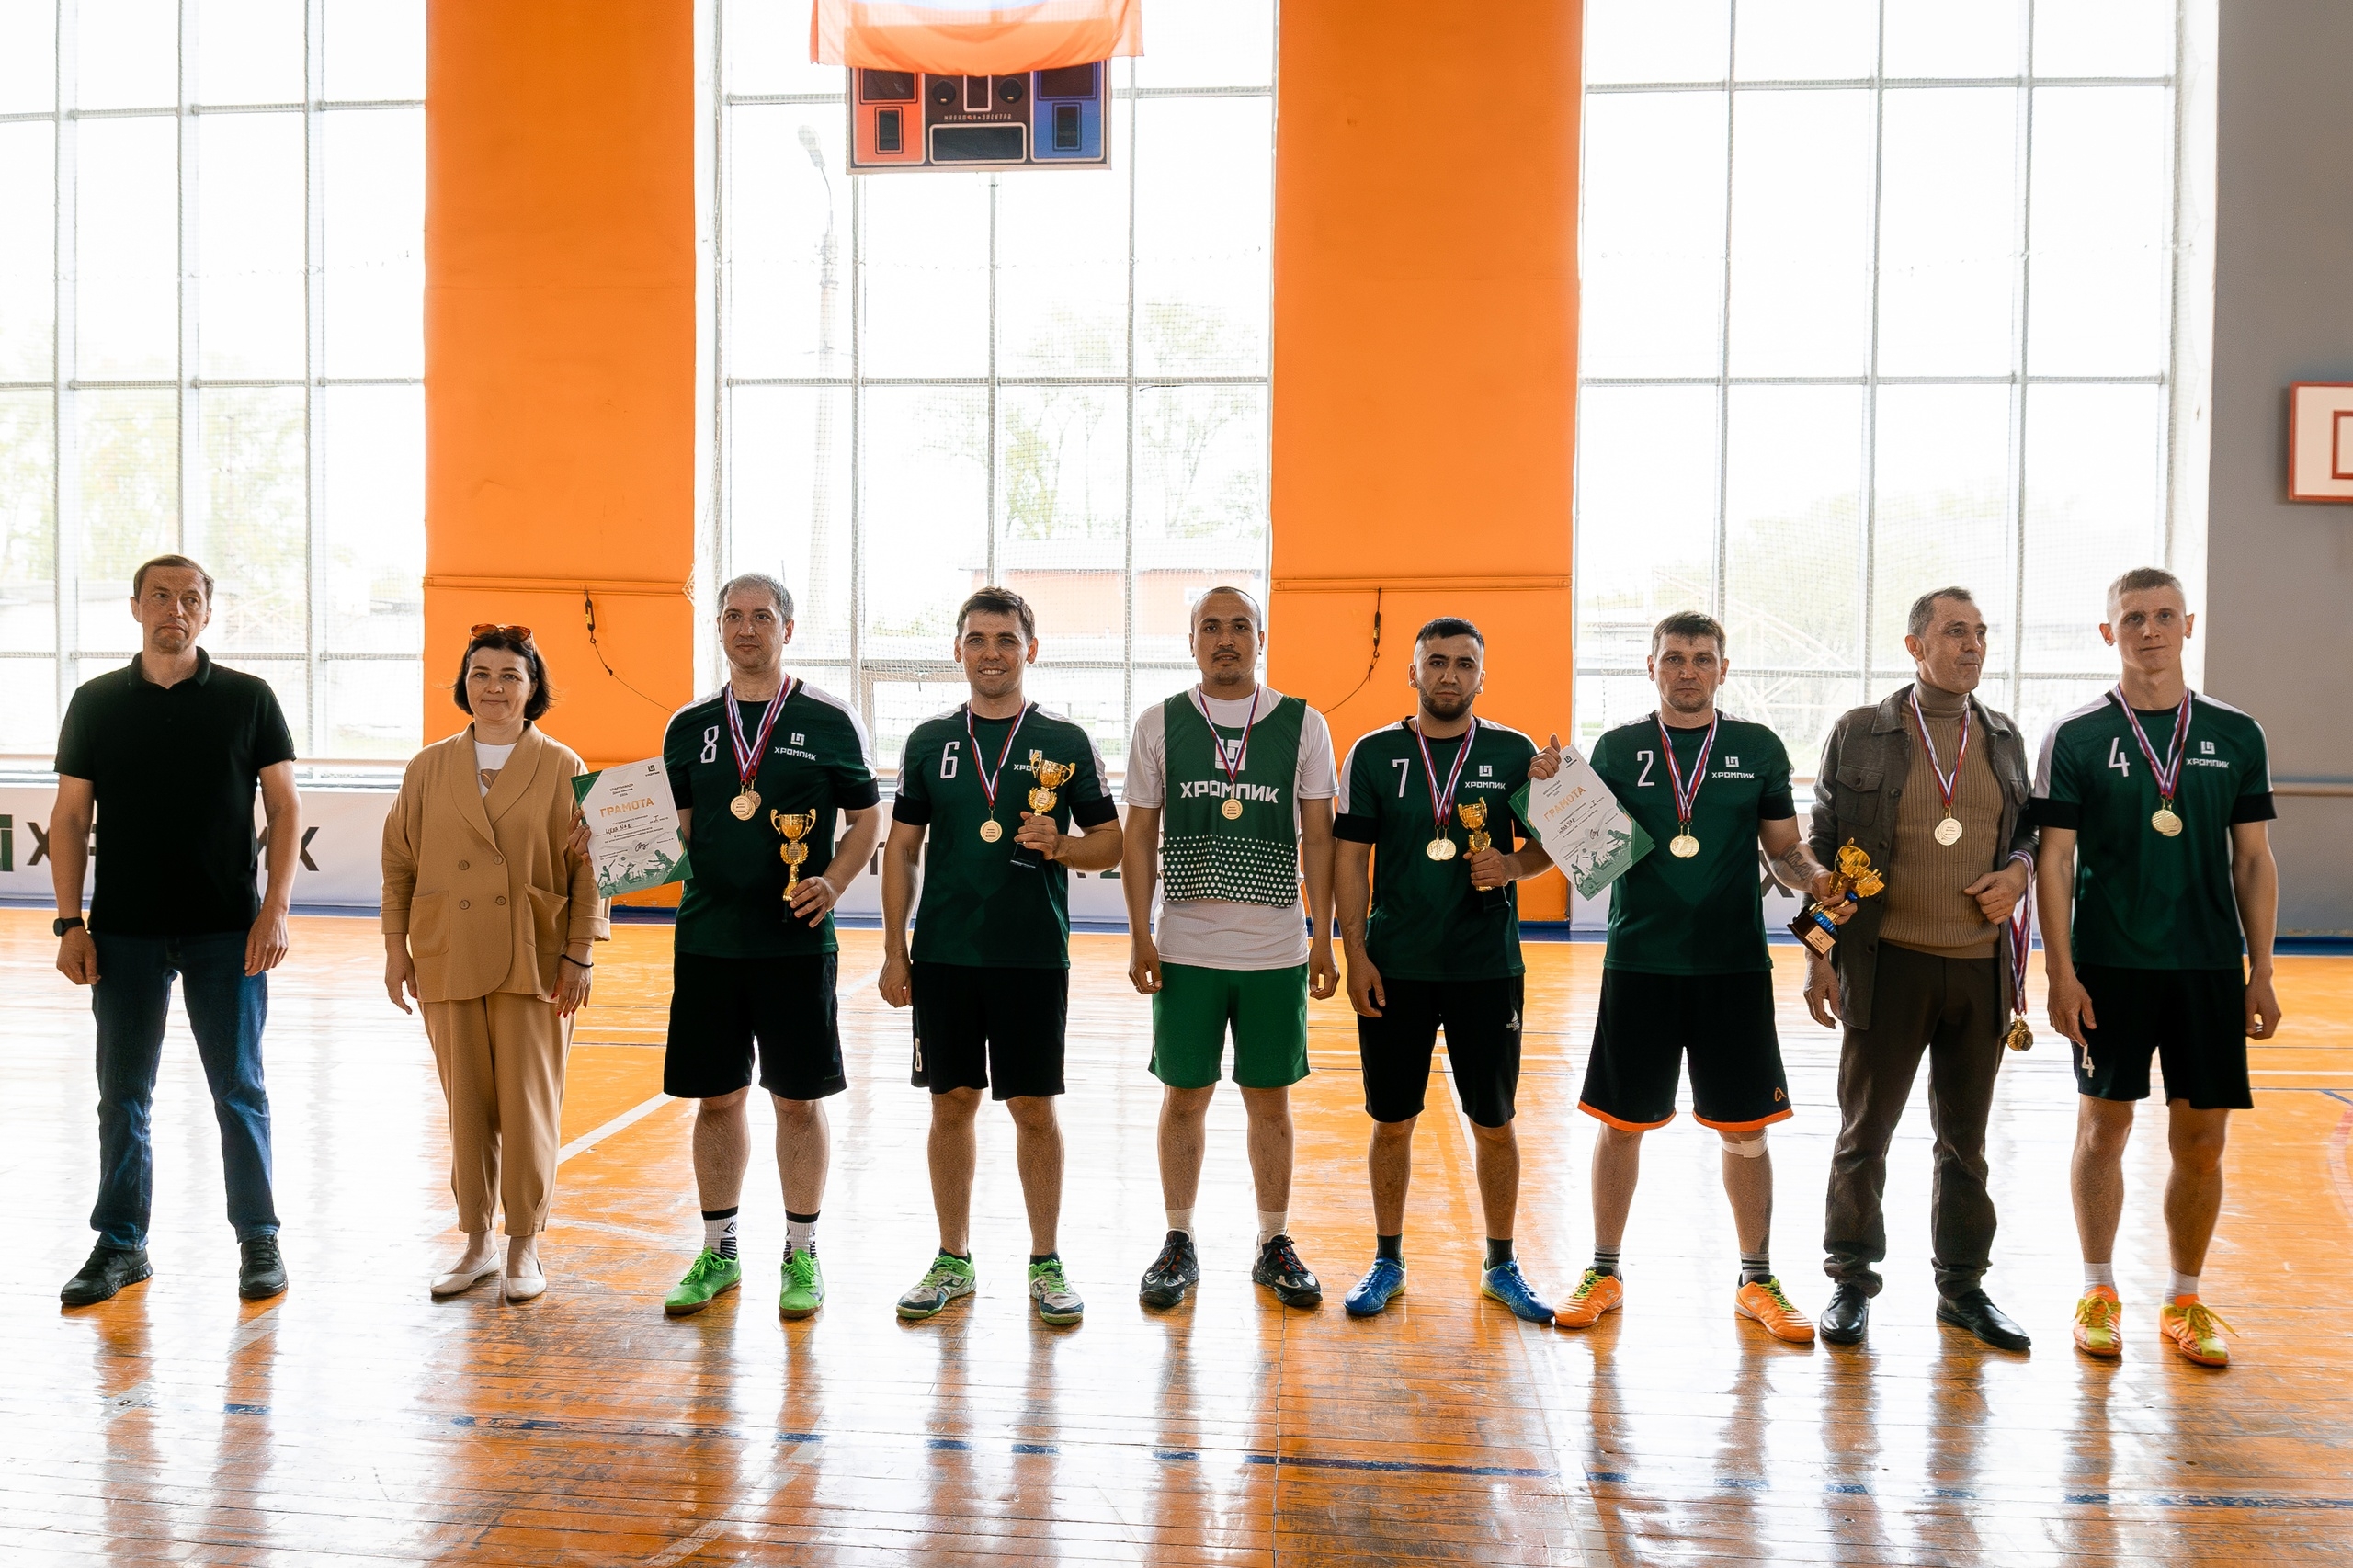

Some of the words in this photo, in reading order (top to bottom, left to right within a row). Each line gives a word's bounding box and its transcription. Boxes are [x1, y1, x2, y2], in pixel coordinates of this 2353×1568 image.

[699, 724, 720, 764] 8
[773, 745, 818, 762] ХРОМПИК
[939, 740, 961, 779] 6
[2108, 736, 2131, 778] 4
[1392, 758, 1410, 799] 7
[1636, 749, 1655, 788] 2
[1711, 771, 1756, 779] ХРОМПИК
[2185, 757, 2230, 769] ХРОМПИК
[1179, 780, 1280, 804] ХРОМПИК
[1464, 781, 1506, 790] ХРОМПИК
[599, 797, 654, 818] ГРАМОТА
[1543, 786, 1586, 823] ГРАМОТА
[2081, 1043, 2096, 1078] 4
